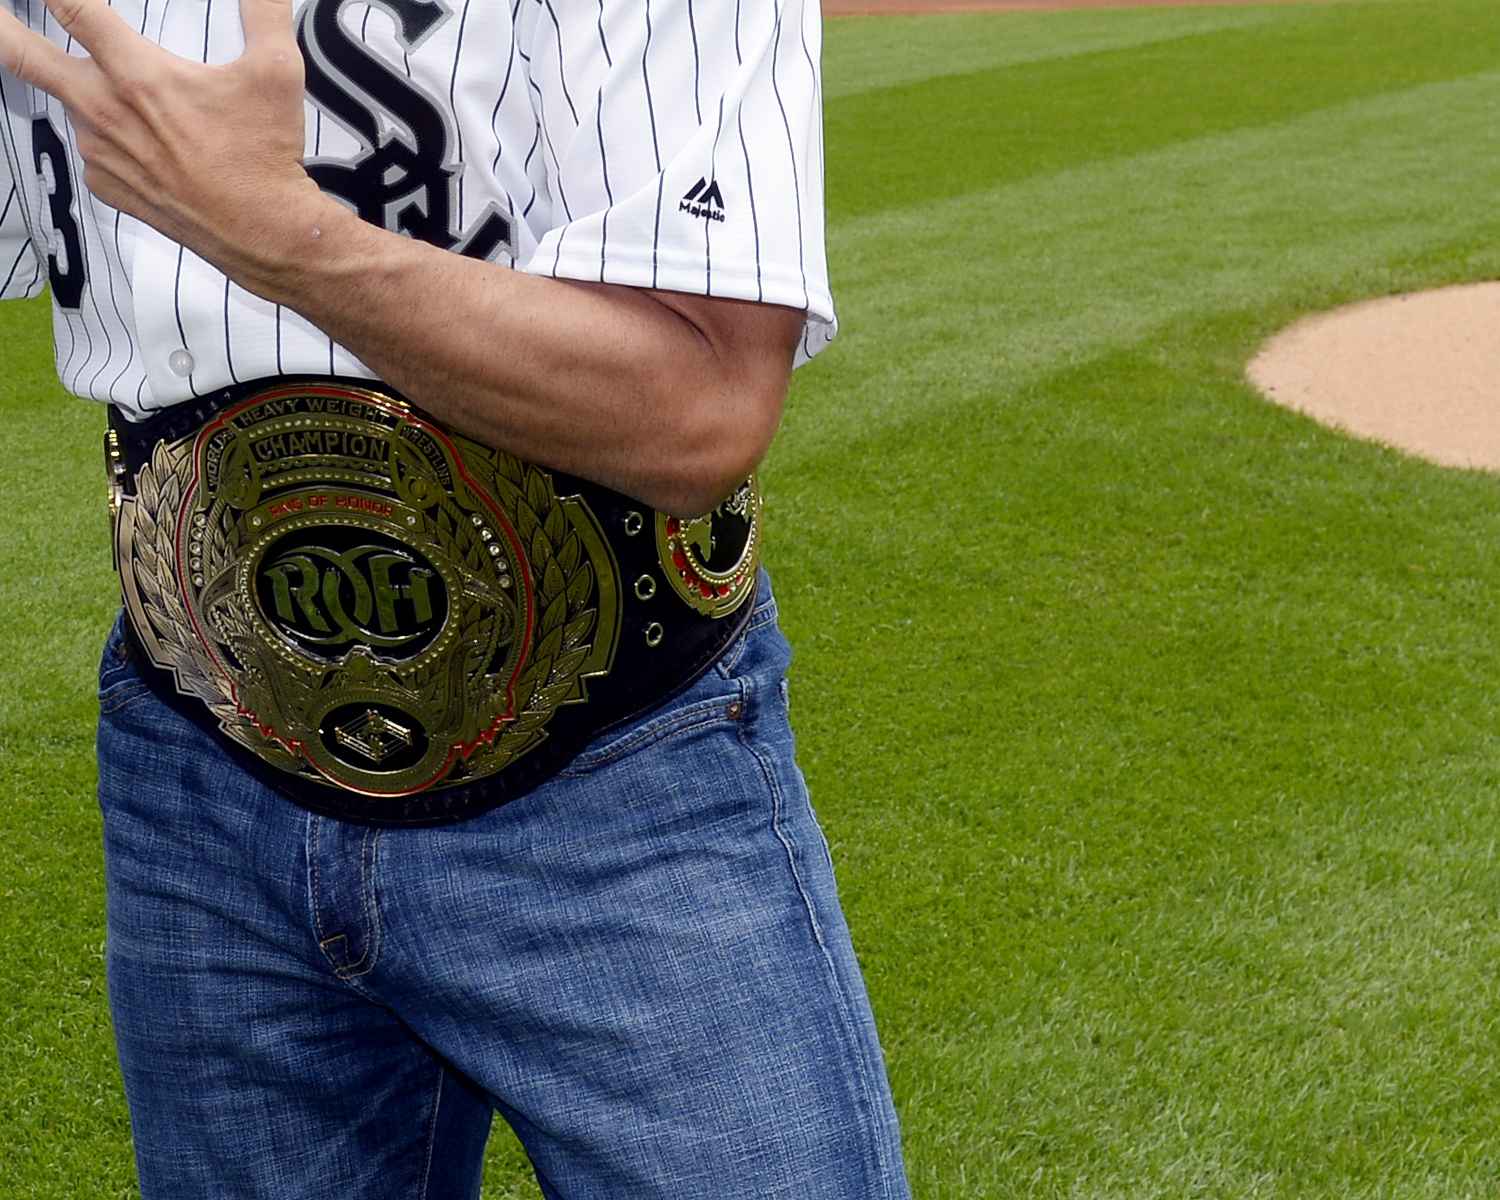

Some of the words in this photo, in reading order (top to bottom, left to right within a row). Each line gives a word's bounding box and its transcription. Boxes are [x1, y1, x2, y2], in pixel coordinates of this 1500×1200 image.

[678, 200, 726, 224] Majestic
[239, 398, 299, 428] HEAVY
[306, 399, 392, 426] WEIGHT
[254, 431, 386, 462] CHAMPION
[401, 426, 452, 486] WRESTLING
[268, 496, 304, 517] RING
[308, 495, 329, 509] OF
[335, 496, 395, 517] HONOR
[262, 544, 437, 647] ROH
